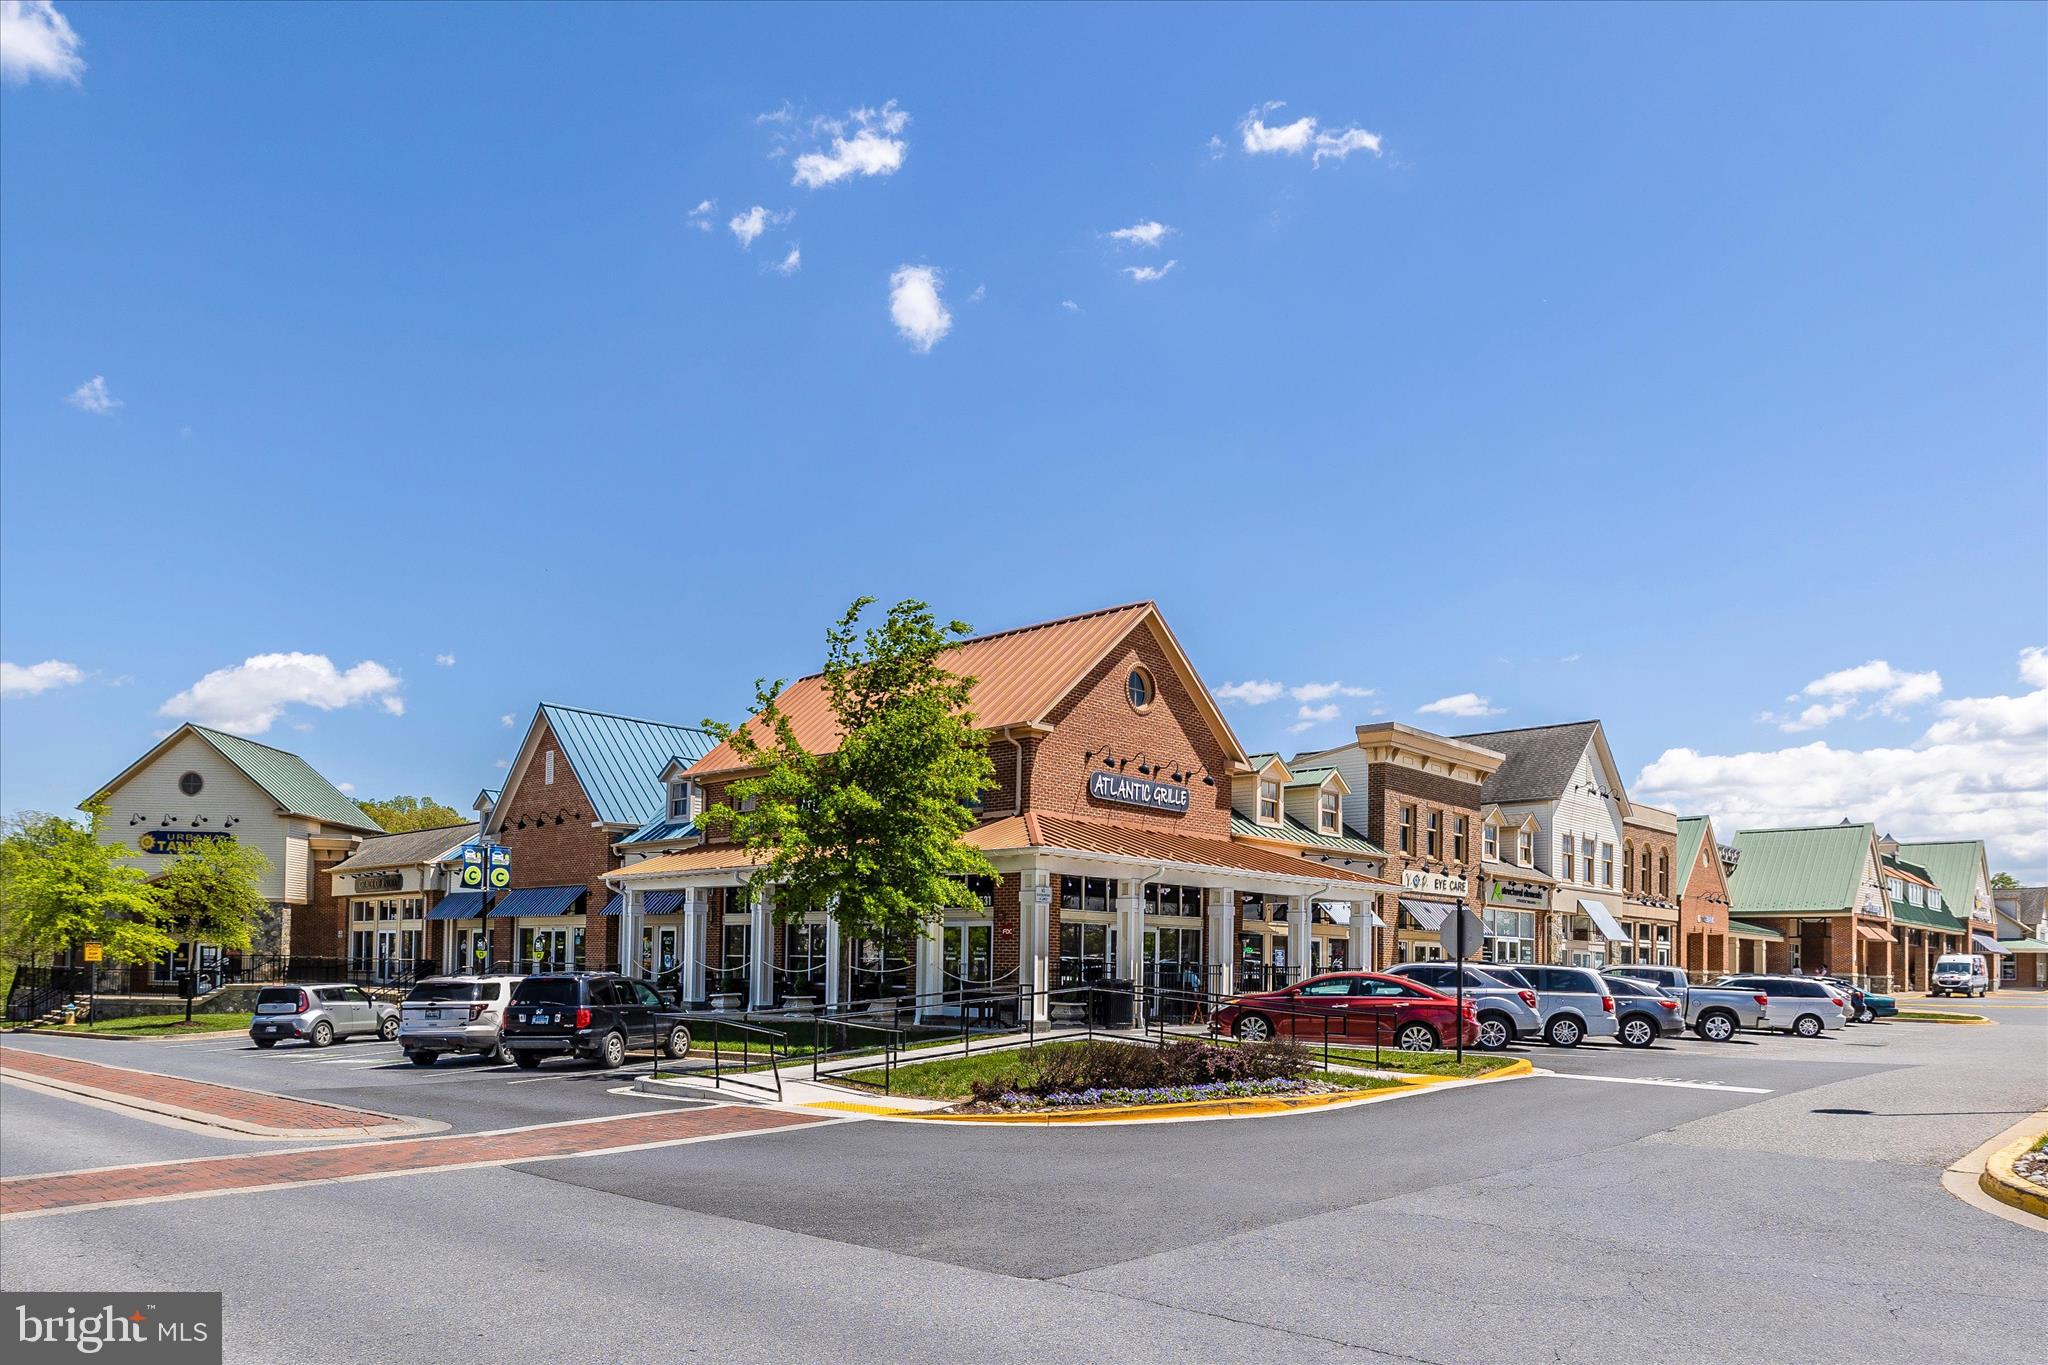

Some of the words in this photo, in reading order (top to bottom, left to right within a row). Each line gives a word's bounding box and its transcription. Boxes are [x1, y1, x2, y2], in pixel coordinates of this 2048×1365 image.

[1094, 774, 1151, 801] ATLANTIC
[1153, 786, 1187, 806] GRILLE
[166, 833, 220, 842] URBANA
[469, 870, 477, 881] C
[495, 872, 505, 883] C
[1434, 878, 1448, 890] EYE
[1449, 880, 1467, 892] CARE
